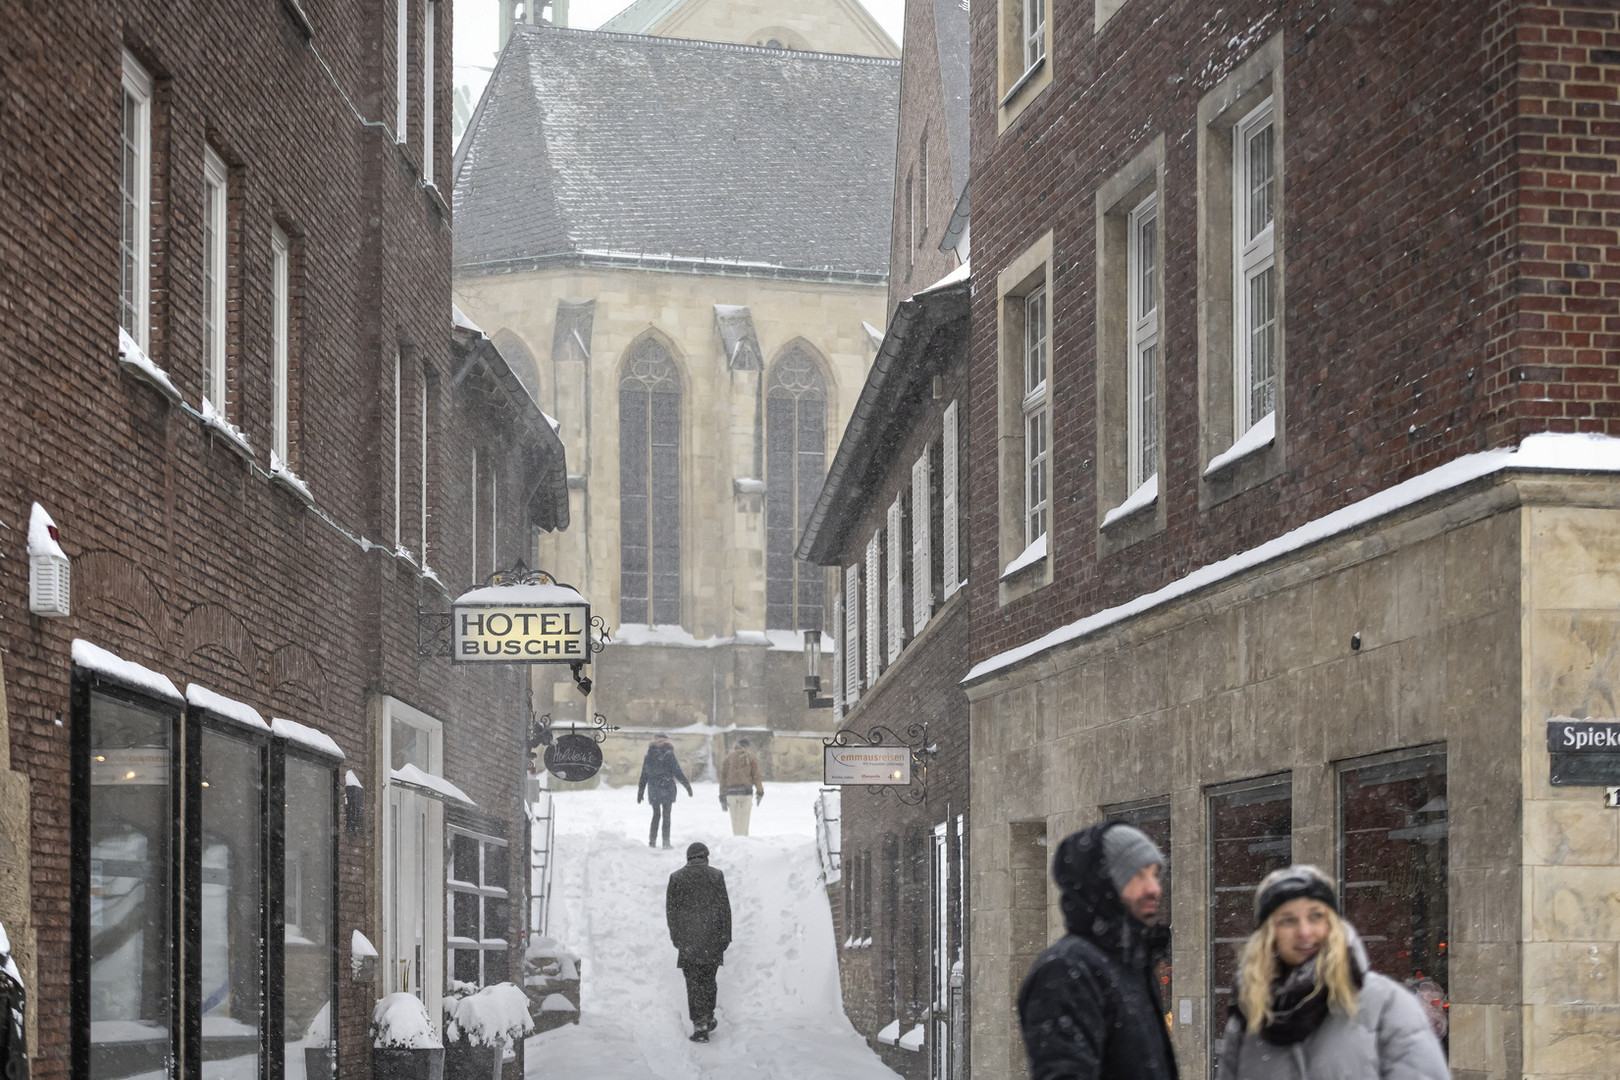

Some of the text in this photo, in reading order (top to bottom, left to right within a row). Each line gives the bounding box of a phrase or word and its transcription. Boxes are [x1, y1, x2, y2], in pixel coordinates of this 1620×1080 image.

[461, 613, 582, 636] HOTEL
[462, 640, 581, 655] BUSCHE
[1563, 727, 1620, 749] Spiek
[841, 753, 905, 761] emmausreisen
